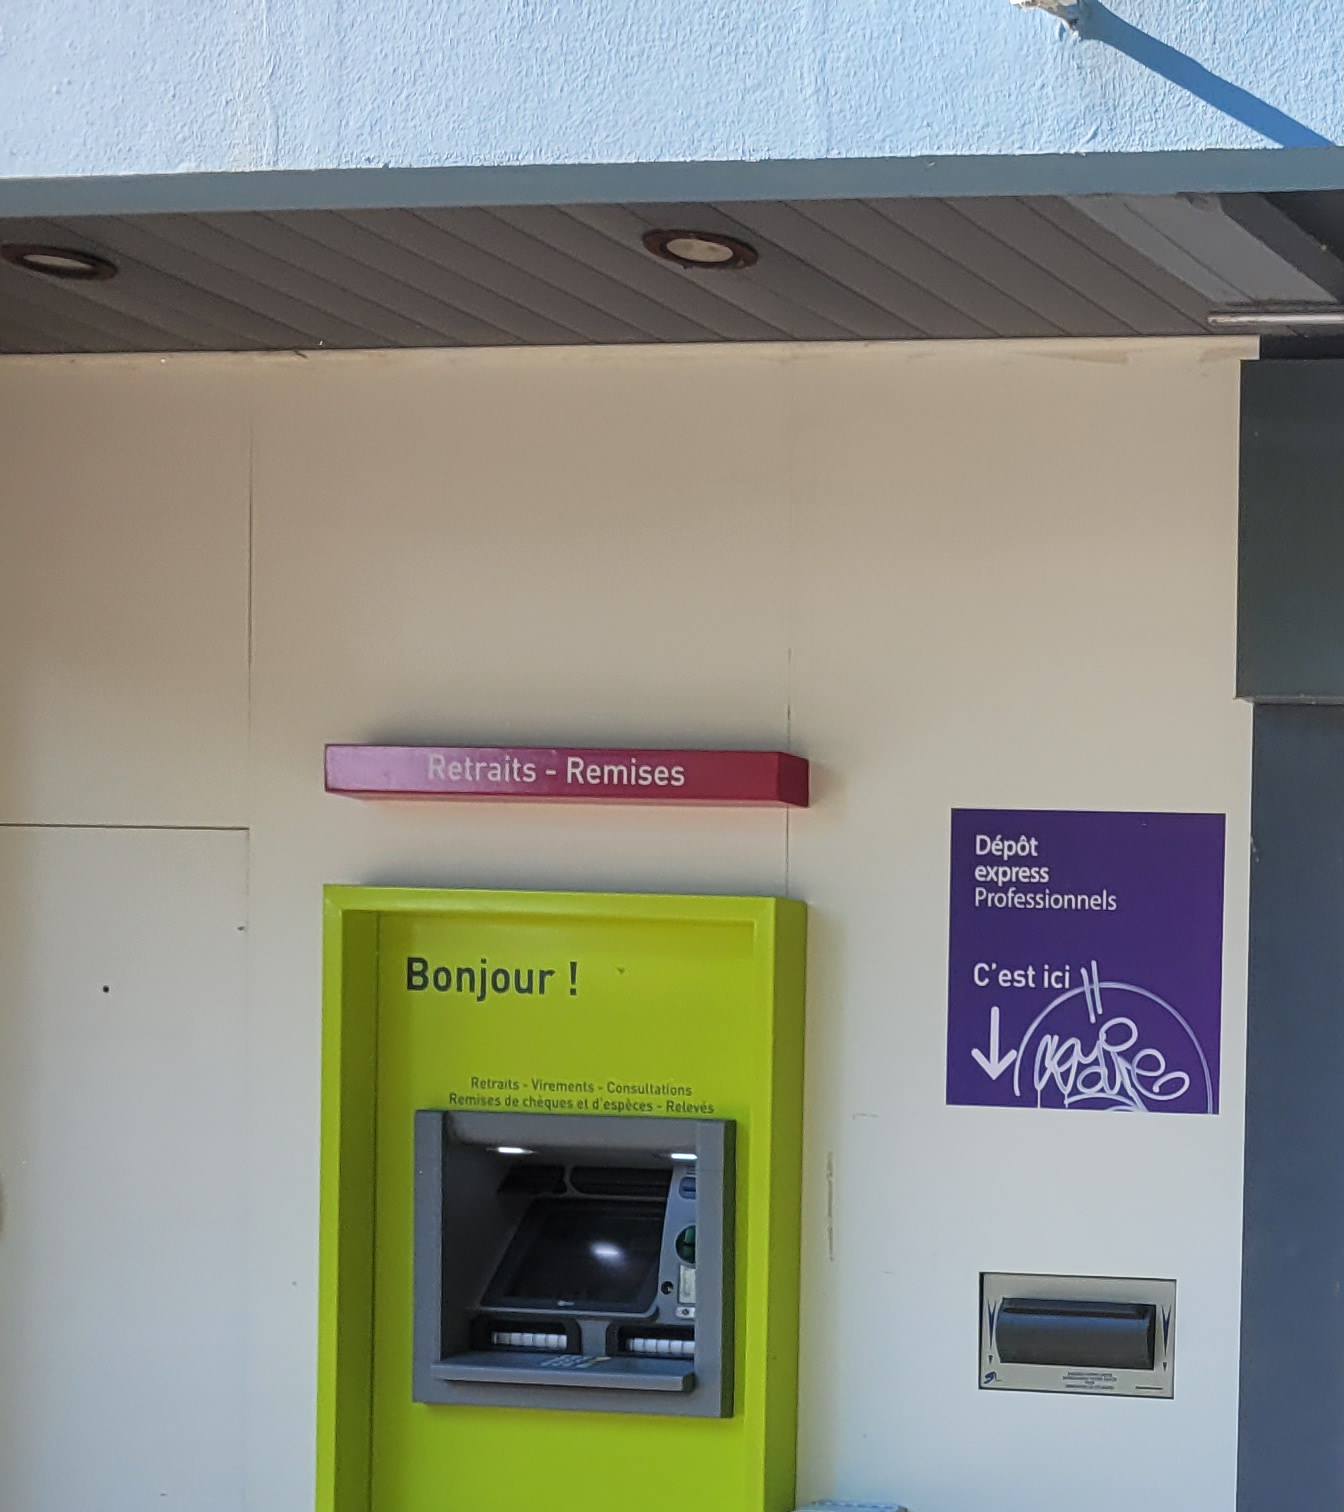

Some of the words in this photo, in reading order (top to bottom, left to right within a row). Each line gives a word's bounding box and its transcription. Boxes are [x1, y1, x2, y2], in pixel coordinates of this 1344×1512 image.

[428, 753, 536, 784] Retraits
[566, 757, 686, 787] Remises
[975, 834, 1039, 860] Dépôt
[974, 866, 1049, 886] express
[974, 887, 1117, 911] Professionnels
[406, 957, 556, 1002] Bonjour
[568, 961, 579, 996] !
[973, 962, 1036, 988] C'est
[1043, 965, 1071, 989] ici
[471, 1077, 519, 1090] Retraits
[531, 1079, 594, 1093] Virements
[607, 1081, 692, 1096] Consultations
[449, 1093, 500, 1106] Remises
[505, 1094, 519, 1107] de
[522, 1095, 573, 1111] chèques
[577, 1097, 589, 1109] et
[592, 1097, 653, 1113] d'espèces
[666, 1100, 715, 1114] Relevés
